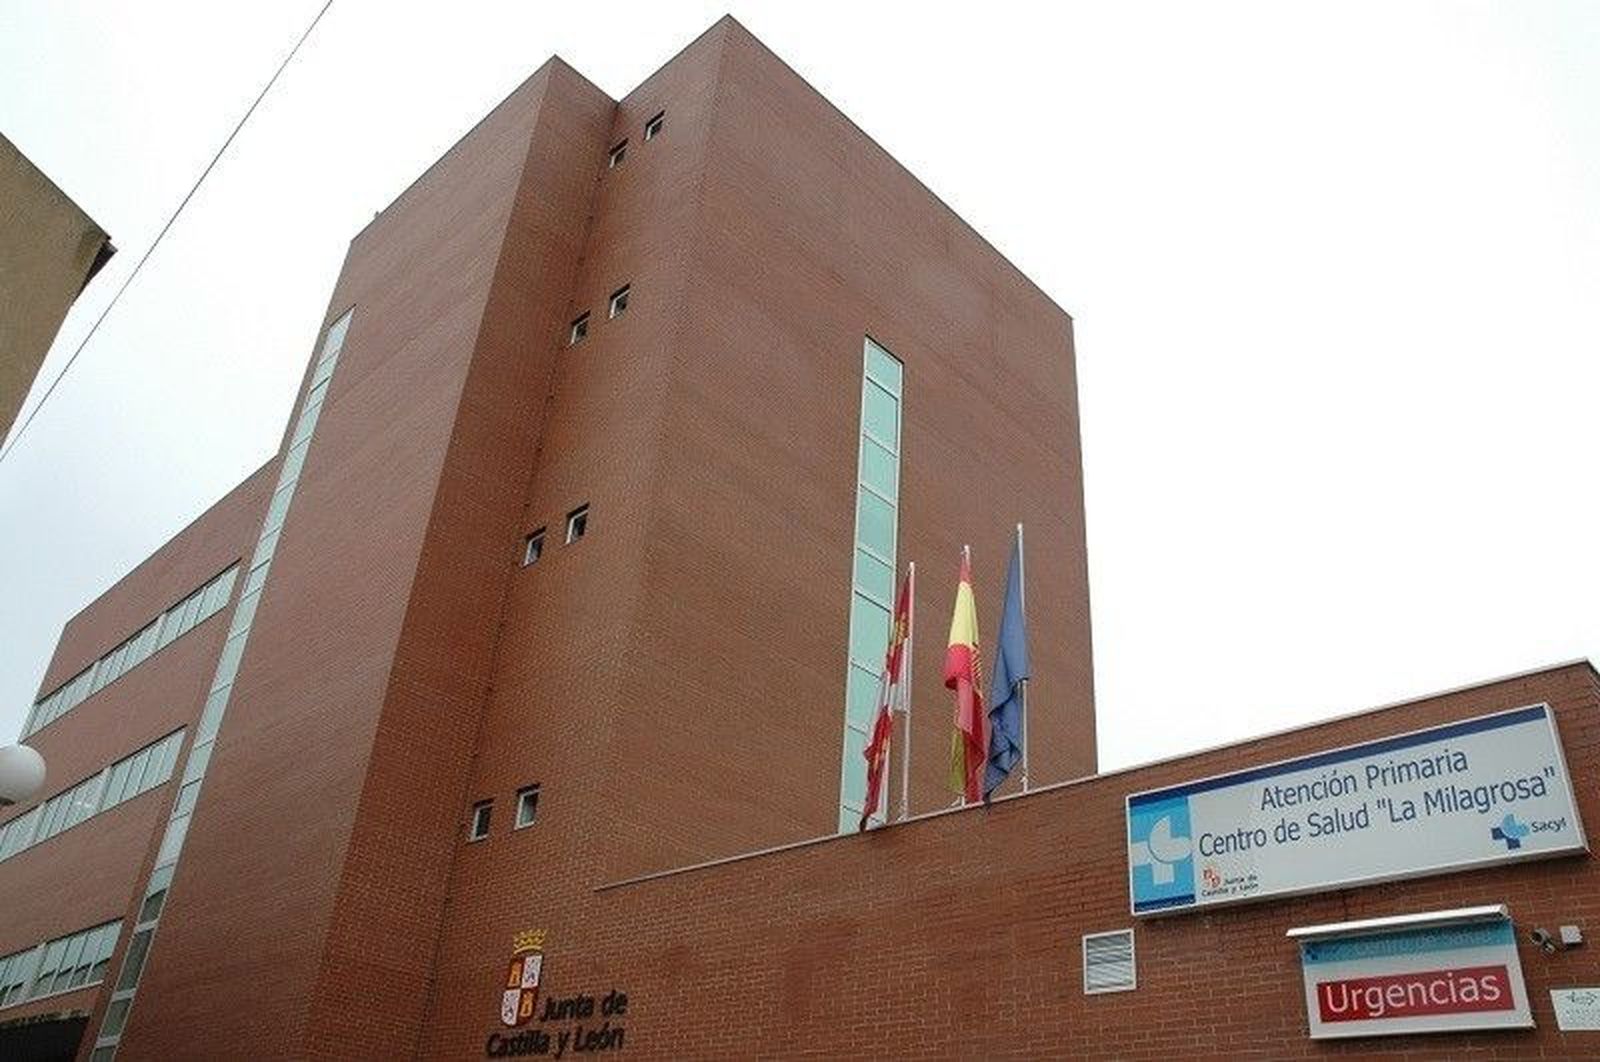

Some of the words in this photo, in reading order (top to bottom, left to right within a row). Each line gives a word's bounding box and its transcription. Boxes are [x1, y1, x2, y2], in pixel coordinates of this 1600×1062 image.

[1261, 769, 1357, 810] Atención
[1365, 749, 1468, 788] Primaria
[1199, 828, 1267, 857] Centro
[1274, 818, 1301, 844] de
[1307, 803, 1369, 838] Salud
[1376, 797, 1416, 822] "La
[1423, 766, 1555, 813] Milagrosa"
[541, 992, 594, 1022] Junta
[602, 990, 628, 1016] de
[1326, 973, 1501, 1016] Urgencias
[487, 1030, 550, 1058] Castilla
[554, 1031, 570, 1060] y
[573, 1022, 624, 1052] León
